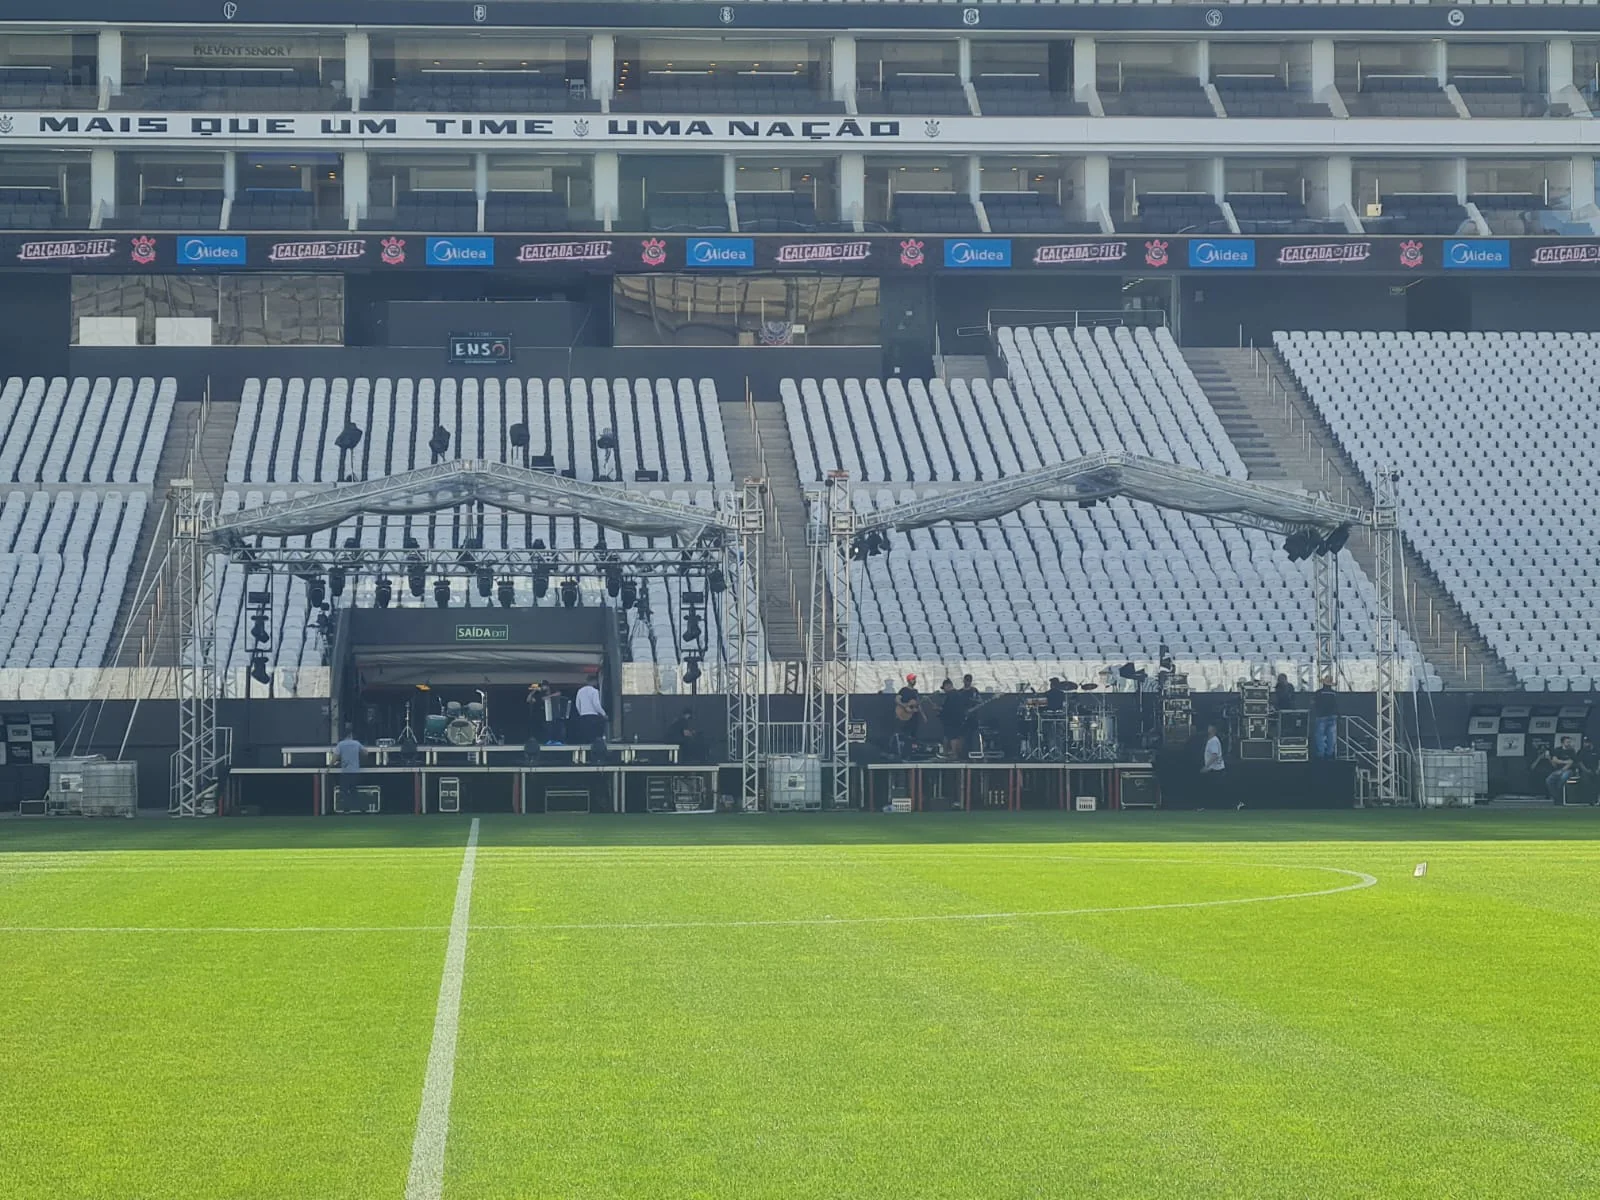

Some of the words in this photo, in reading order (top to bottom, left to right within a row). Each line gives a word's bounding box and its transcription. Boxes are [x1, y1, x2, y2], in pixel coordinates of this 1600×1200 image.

[193, 45, 242, 56] PREVENT
[39, 116, 168, 133] MAIS
[191, 117, 295, 136] QUE
[320, 118, 397, 134] UM
[425, 119, 553, 135] TIME
[607, 119, 714, 136] UMA
[728, 118, 900, 140] NAÇÃO
[86, 241, 108, 254] FIEL
[194, 245, 239, 258] Midea
[336, 242, 358, 255] FIEL
[442, 247, 487, 259] Midea
[583, 243, 606, 256] FIEL
[703, 247, 747, 260] Midea
[842, 244, 864, 257] FIEL
[1099, 244, 1120, 257] FIEL
[1342, 245, 1364, 258] FIEL
[961, 248, 1004, 261] Midea
[1206, 249, 1249, 261] Midea
[1461, 250, 1503, 262] Midea
[458, 626, 491, 638] SAÍDA
